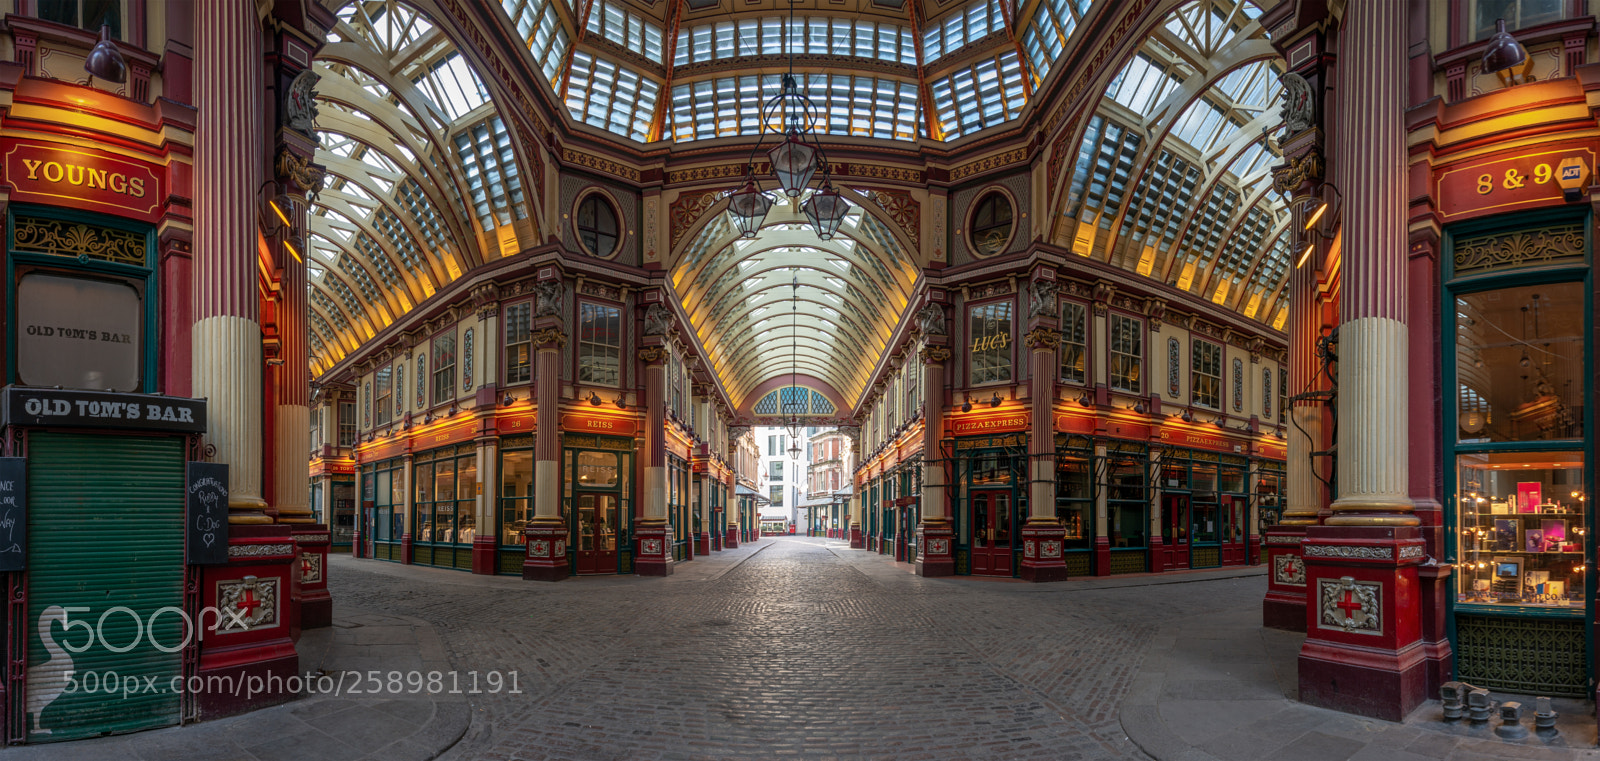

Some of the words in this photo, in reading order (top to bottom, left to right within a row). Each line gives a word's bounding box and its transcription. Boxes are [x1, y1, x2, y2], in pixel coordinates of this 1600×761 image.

[22, 158, 146, 198] YOUNGS
[1476, 173, 1494, 195] 8
[1503, 168, 1525, 190] &
[1533, 162, 1553, 185] 9
[1562, 166, 1580, 178] ADT
[26, 325, 55, 338] OLD
[57, 326, 98, 341] TOM'S
[101, 331, 132, 344] BAR
[972, 331, 1009, 352] LUC'S
[25, 397, 71, 416] OLD
[76, 399, 141, 420] TOM'S
[146, 403, 194, 423] BAR
[511, 420, 521, 428] 26
[587, 420, 613, 429] REISS
[956, 418, 1024, 431] PIZZAEXPRESS
[435, 433, 450, 442] REISS
[1160, 432, 1170, 440] 20
[1186, 435, 1229, 448] PIZZAEXPRESS
[582, 465, 613, 474] REISS
